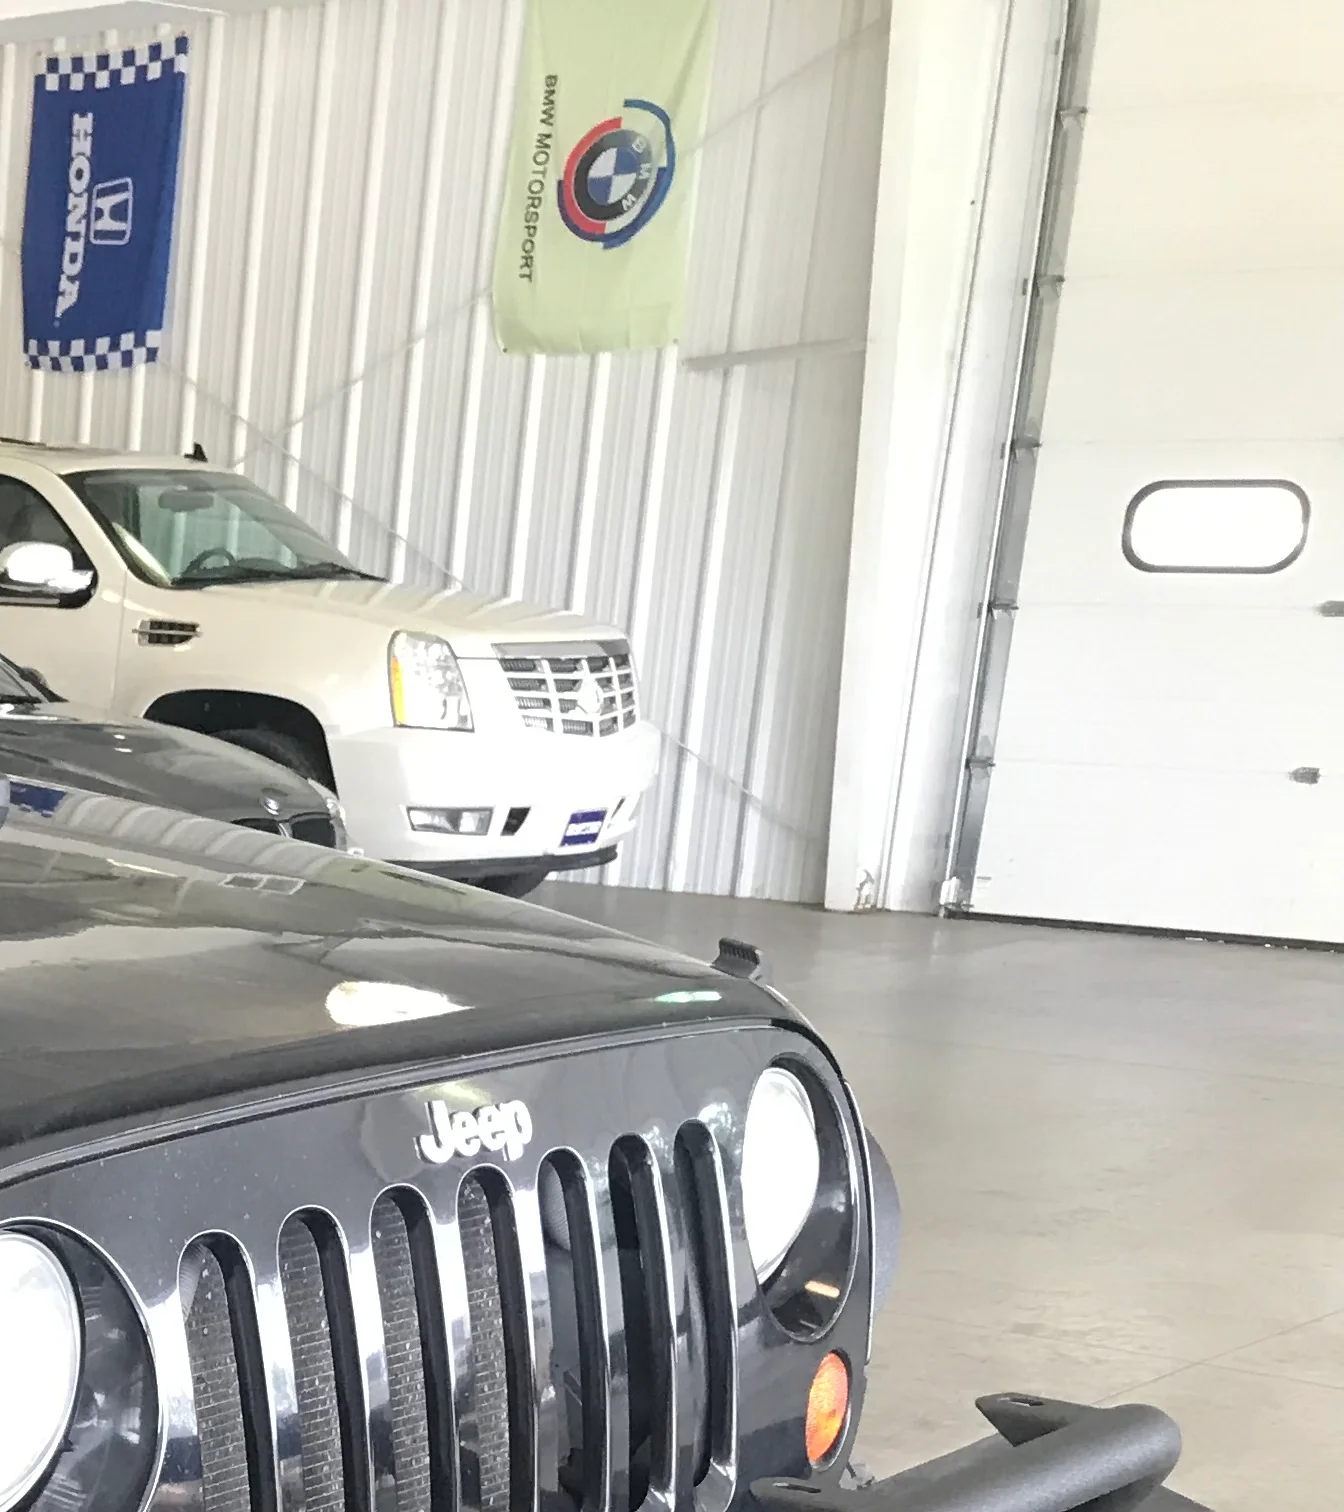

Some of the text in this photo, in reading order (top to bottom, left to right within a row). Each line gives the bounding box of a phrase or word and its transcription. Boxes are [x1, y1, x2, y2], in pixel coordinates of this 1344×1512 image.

[55, 112, 93, 318] HONDA
[518, 75, 558, 283] BMW MOTORSPORT
[413, 1099, 533, 1164] Jeep
